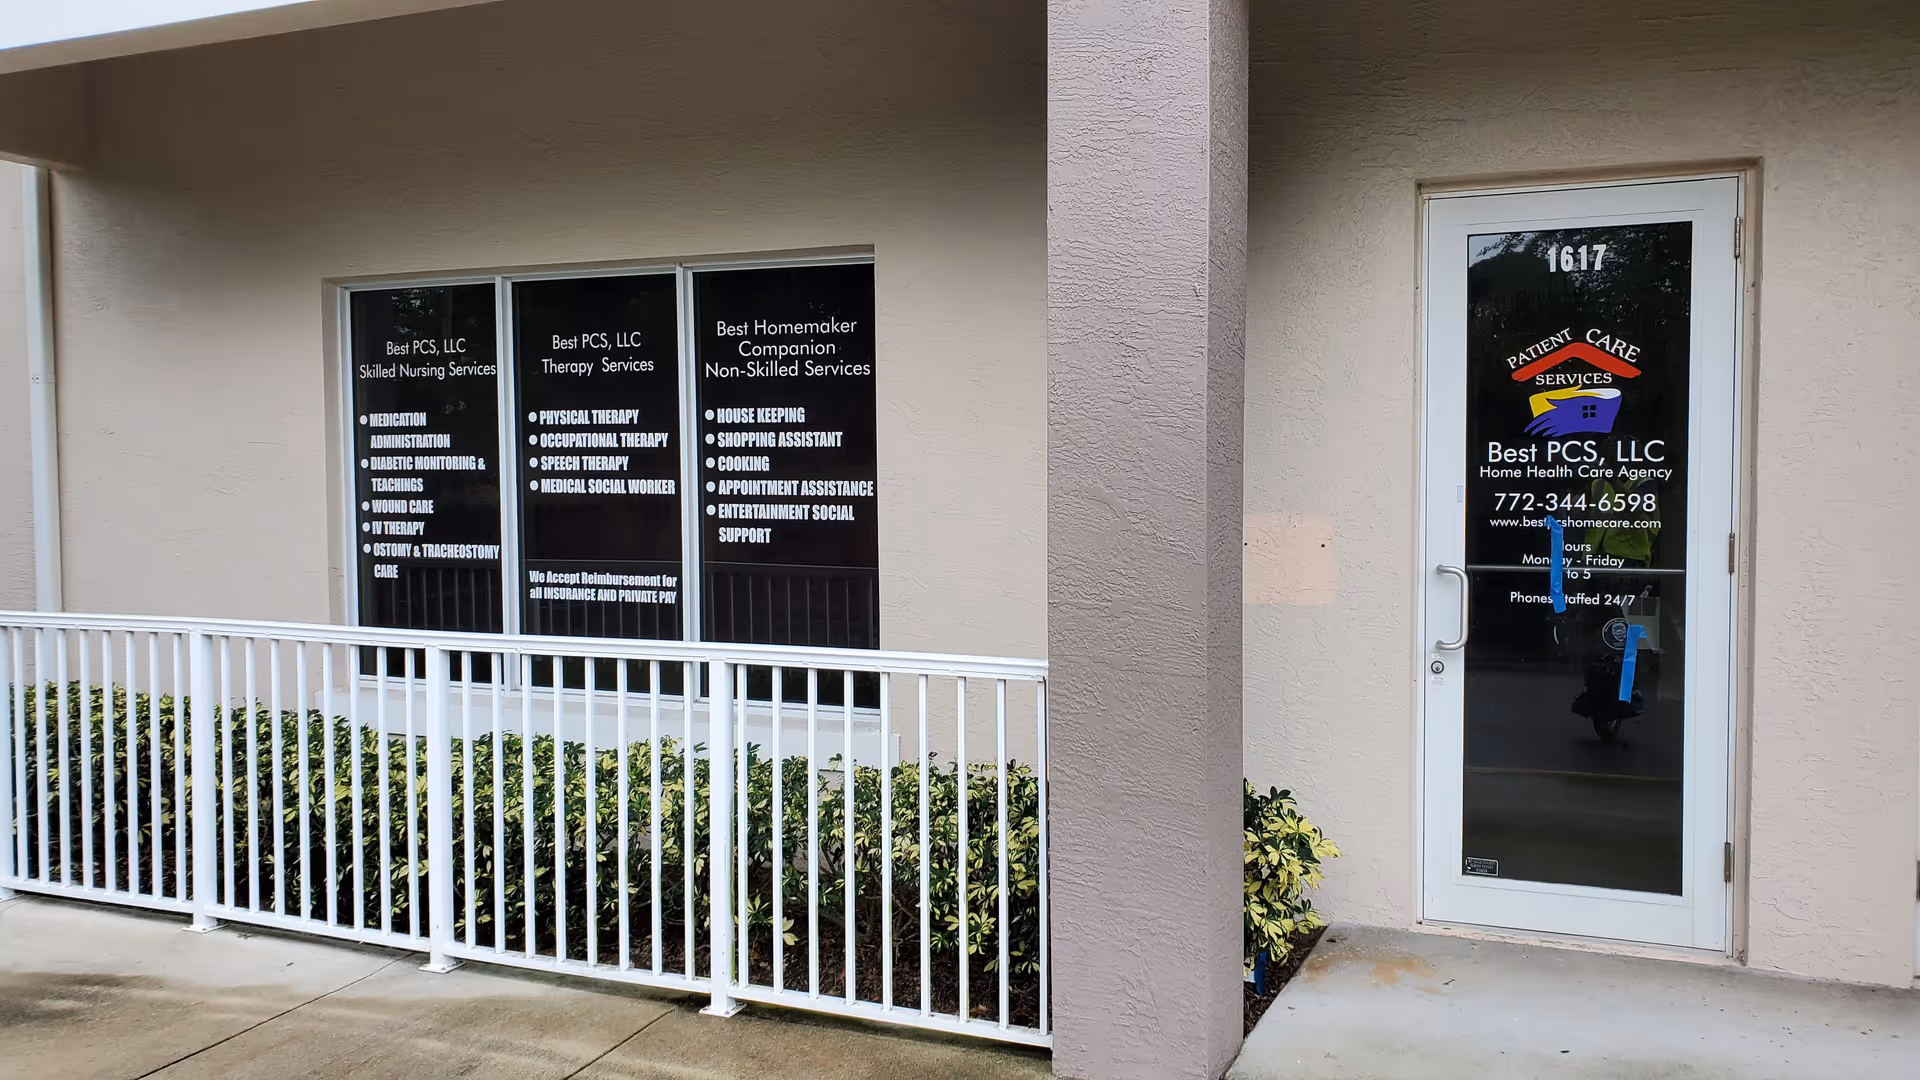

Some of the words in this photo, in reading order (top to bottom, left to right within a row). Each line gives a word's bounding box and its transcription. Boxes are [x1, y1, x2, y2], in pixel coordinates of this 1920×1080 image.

[1548, 244, 1607, 273] 1617
[716, 320, 749, 337] Best
[754, 317, 858, 335] Homemaker
[387, 340, 409, 355] Best
[413, 339, 440, 356] PCS,
[443, 338, 466, 354] LLC
[552, 335, 578, 350] Best
[582, 333, 612, 351] PCS,
[616, 332, 641, 348] LLC
[738, 339, 836, 360] Companion
[1506, 327, 1573, 369] PATIENT
[1585, 328, 1641, 363] CARE
[359, 363, 396, 379] Skilled
[399, 363, 445, 381] Nursing
[448, 360, 497, 376] Services
[541, 358, 594, 377] Therapy
[601, 357, 654, 372] Services
[705, 360, 799, 378] Non-Skilled
[804, 360, 871, 376] Services
[1535, 372, 1612, 386] SERVICES
[369, 412, 427, 427] MEDICATION
[539, 410, 590, 425] PHYSICAL
[591, 409, 640, 424] THERAPY
[717, 408, 755, 424] HOUSE
[757, 407, 806, 423] KEEPING
[370, 433, 450, 449] ADMINISTRATION
[540, 433, 619, 448] OCCUPATIONAL
[620, 432, 669, 448] THERAPY
[717, 432, 776, 448] SHOPPING
[778, 431, 843, 447] ASSISTANT
[1488, 442, 1538, 463] Best
[1547, 441, 1606, 466] PCS,
[1616, 440, 1666, 461] LLC
[370, 456, 413, 471] DIABETIC
[414, 456, 476, 471] MONITORING
[477, 457, 486, 471] &
[540, 456, 580, 471] SPEECH
[581, 455, 629, 471] THERAPY
[718, 456, 770, 472] COOKING
[1480, 466, 1522, 478] Home
[1526, 465, 1573, 478] Health
[1577, 465, 1614, 478] Care
[1618, 466, 1672, 481] Agency
[371, 478, 424, 493] TEACHINGS
[541, 479, 587, 494] MEDICAL
[588, 479, 626, 494] SOCIAL
[627, 479, 676, 495] WORKER
[718, 480, 799, 496] APPOINTMENT
[801, 480, 874, 497] ASSISTANCE
[372, 500, 408, 515] WOUND
[409, 500, 434, 515] CARE
[1494, 492, 1657, 512] 772-344-6598
[718, 504, 810, 520] ENTERTAINMENT
[812, 504, 855, 521] SOCIAL
[372, 521, 383, 536] IV
[384, 521, 425, 536] THERAPY
[718, 528, 772, 544] SUPPORT
[373, 543, 413, 558] OSTOMY
[413, 546, 421, 558] &
[422, 544, 500, 560] TRACHEOSTOMY
[1556, 540, 1592, 552] ours
[1585, 555, 1625, 568] Friday
[374, 564, 399, 579] CARE
[529, 571, 545, 584] We
[546, 571, 580, 585] Accept
[581, 572, 661, 587] Reimbursement
[662, 575, 678, 588] for
[1566, 570, 1579, 580] to
[1582, 569, 1592, 580] 5
[529, 588, 542, 599] all
[543, 587, 596, 602] INSURANCE
[597, 589, 617, 602] AND
[618, 590, 658, 604] PRIVATE
[659, 592, 677, 604] PAY
[1510, 592, 1554, 605] Phones
[1558, 594, 1600, 606] taffed
[1604, 595, 1636, 607] 24/7
